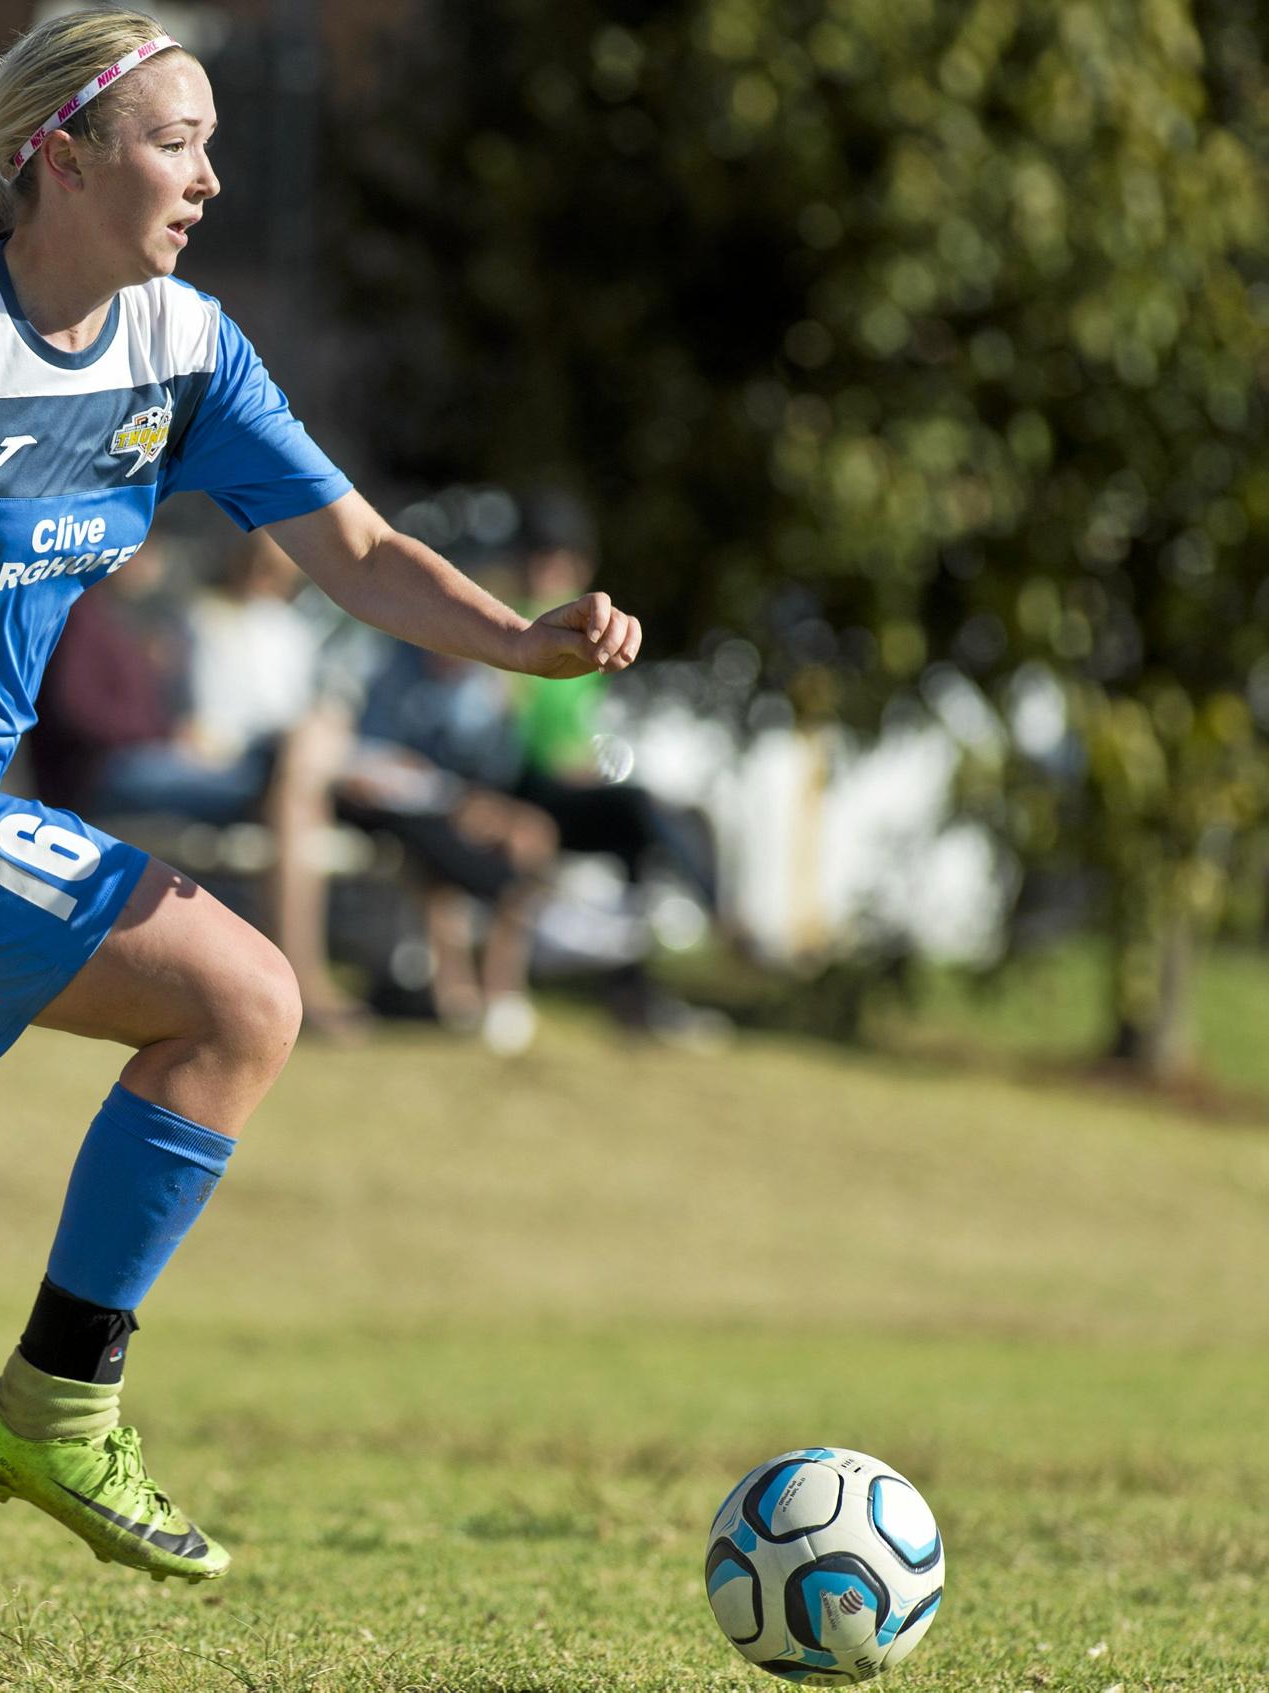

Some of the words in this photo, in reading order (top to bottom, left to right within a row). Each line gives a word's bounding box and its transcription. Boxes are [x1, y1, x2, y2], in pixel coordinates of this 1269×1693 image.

[57, 96, 80, 123] NIKE
[97, 63, 122, 88] NIKE
[137, 40, 159, 59] NIKE
[32, 516, 106, 553] Clive
